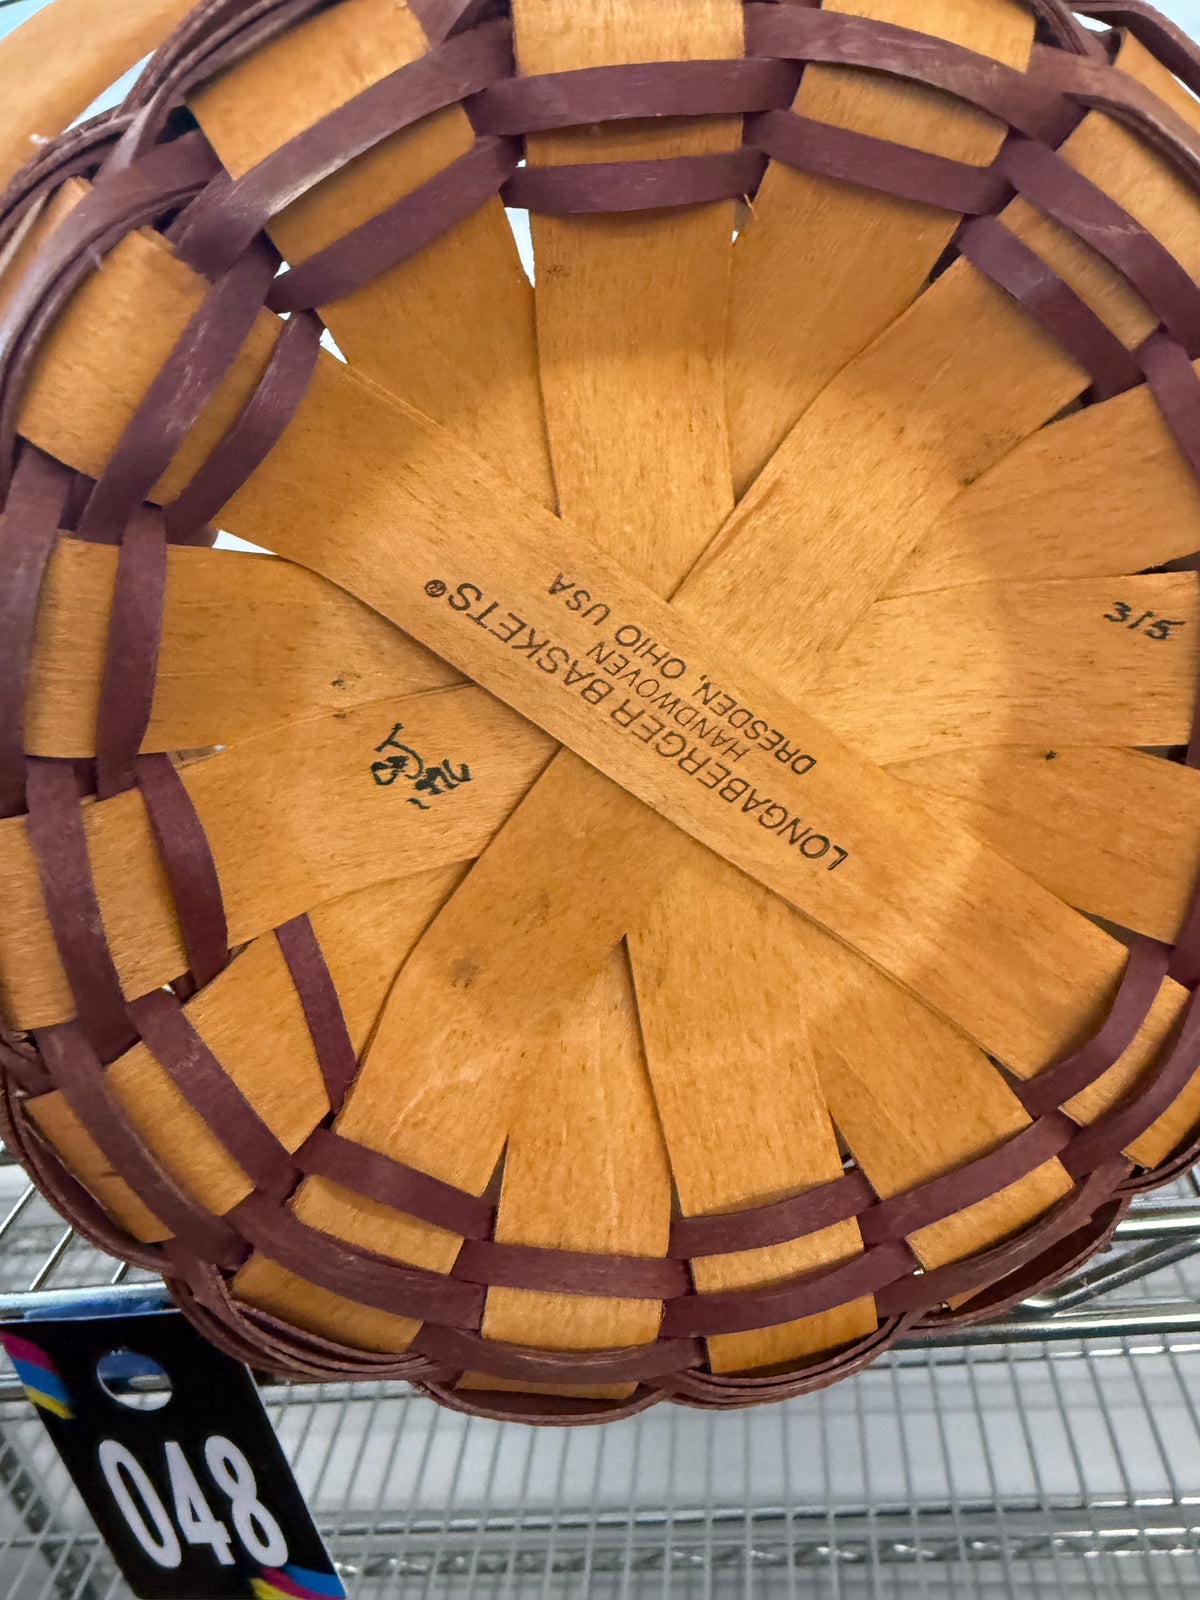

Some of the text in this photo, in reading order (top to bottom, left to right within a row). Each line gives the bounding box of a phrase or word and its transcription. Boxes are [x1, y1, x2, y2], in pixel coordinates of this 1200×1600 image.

[548, 572, 818, 776] DRESDEN, OHIO USA
[586, 641, 750, 763] HANDWOVEN
[610, 698, 849, 871] LONGABERGER
[98, 1435, 289, 1569] 048
